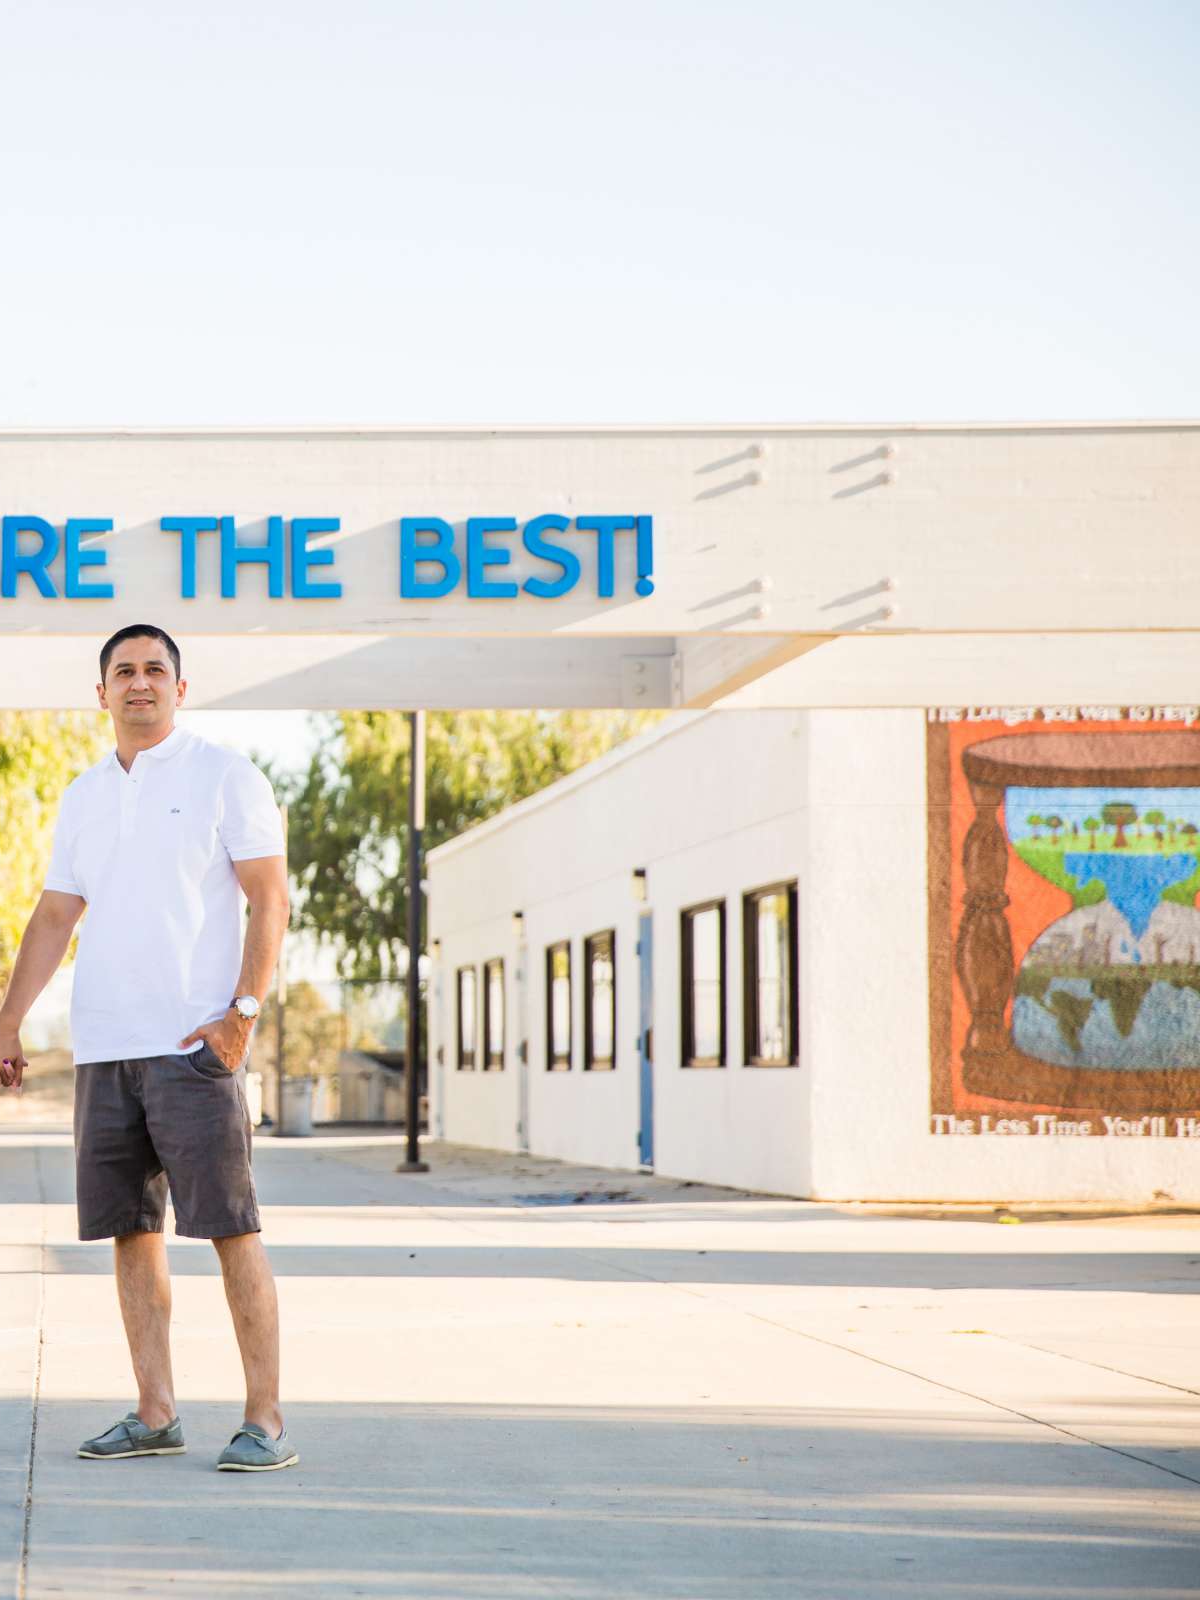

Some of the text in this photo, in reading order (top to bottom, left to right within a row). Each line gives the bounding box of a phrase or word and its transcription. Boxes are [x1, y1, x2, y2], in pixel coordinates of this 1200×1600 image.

[159, 515, 343, 600] THE
[399, 513, 656, 599] BEST!
[931, 1114, 975, 1136] The
[980, 1115, 1031, 1136] Less
[1032, 1115, 1093, 1136] Time
[1102, 1116, 1166, 1137] You'll
